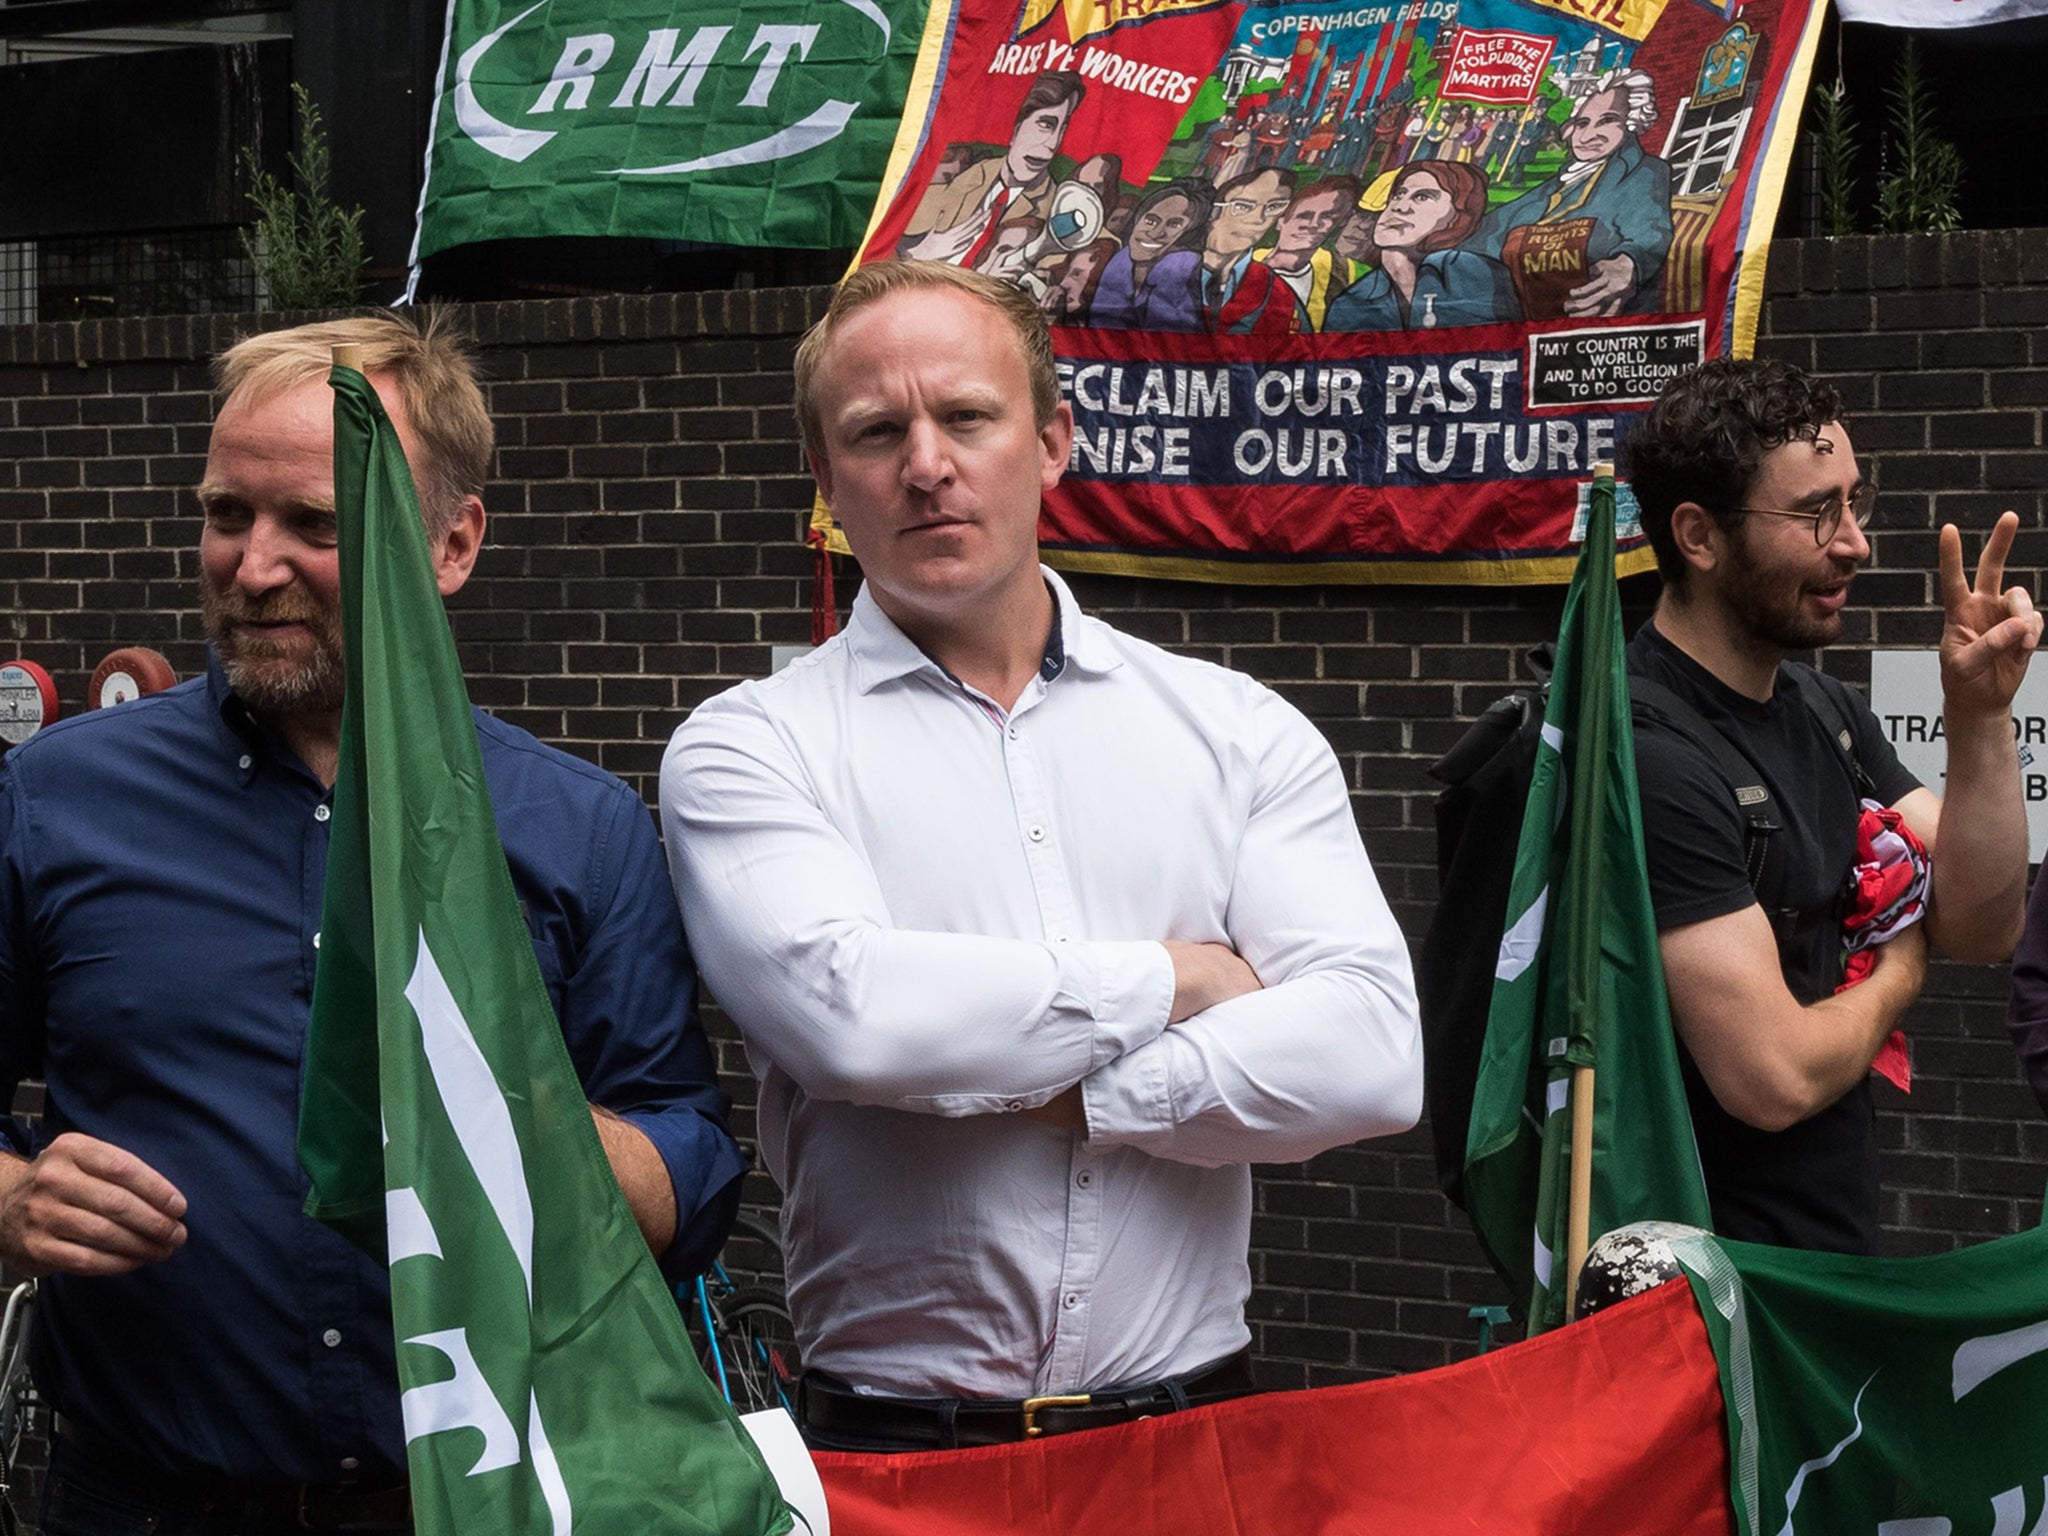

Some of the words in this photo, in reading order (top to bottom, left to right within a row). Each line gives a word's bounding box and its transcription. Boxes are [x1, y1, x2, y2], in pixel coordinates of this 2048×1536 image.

[1251, 6, 1392, 38] COPENHAGEN
[1396, 1, 1457, 22] FIELDS
[1463, 38, 1506, 56] FREE
[1511, 40, 1541, 60] THE
[526, 23, 821, 115] RMT
[1043, 38, 1078, 72] YE
[1079, 46, 1198, 104] WORKERS
[1455, 52, 1535, 74] TOLPUDDLE
[1450, 70, 1533, 89] MARTYRS
[1527, 227, 1590, 245] RIGHTS
[1542, 241, 1566, 251] OF
[1523, 249, 1581, 275] MAN
[1576, 336, 1649, 354] COUNTRY
[1655, 335, 1668, 350] IS
[1674, 333, 1697, 349] THE
[1590, 350, 1647, 367] WORLD
[1544, 369, 1574, 384] AND
[1582, 367, 1607, 382] MY
[1613, 364, 1678, 379] RELIGION
[1254, 368, 1364, 417] OUR
[1385, 357, 1518, 415] PAST
[1568, 383, 1589, 397] TO
[1595, 382, 1618, 395] DO
[1625, 379, 1670, 394] GOO
[1068, 424, 1190, 476] NISE
[1233, 427, 1348, 477] OUR
[1385, 418, 1615, 474] FUTURE
